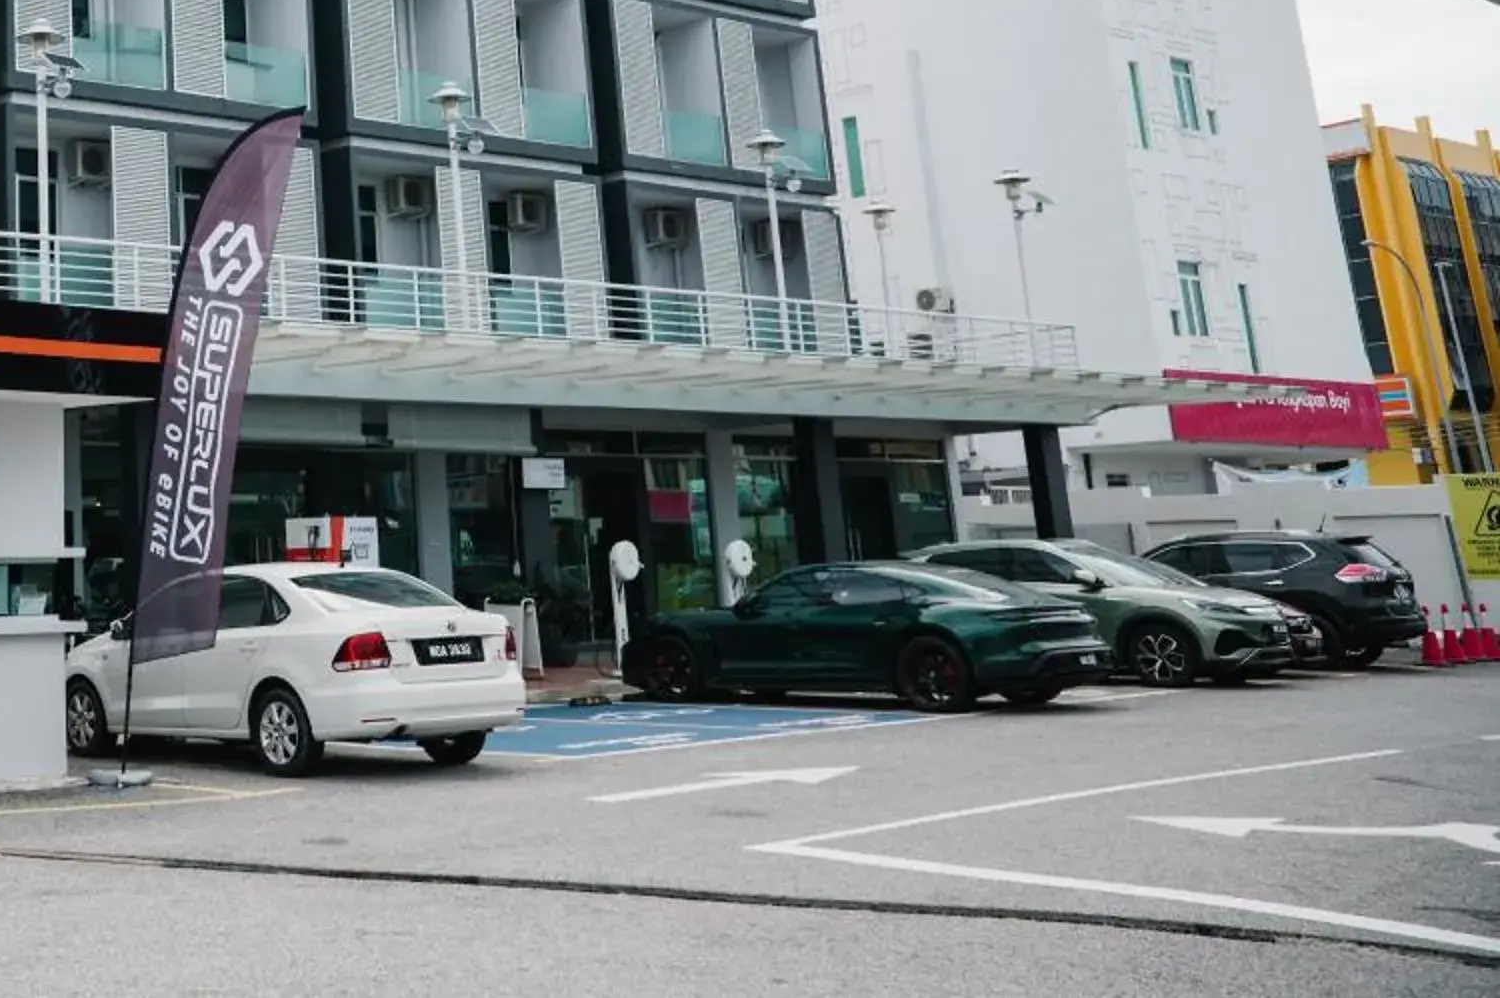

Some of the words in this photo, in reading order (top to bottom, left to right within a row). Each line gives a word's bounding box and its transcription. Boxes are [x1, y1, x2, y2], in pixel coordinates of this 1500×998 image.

[181, 295, 203, 347] THE
[169, 355, 191, 414] JOY
[163, 422, 183, 461] OF
[180, 313, 233, 556] SUPERLUX
[149, 473, 174, 559] eBIKE
